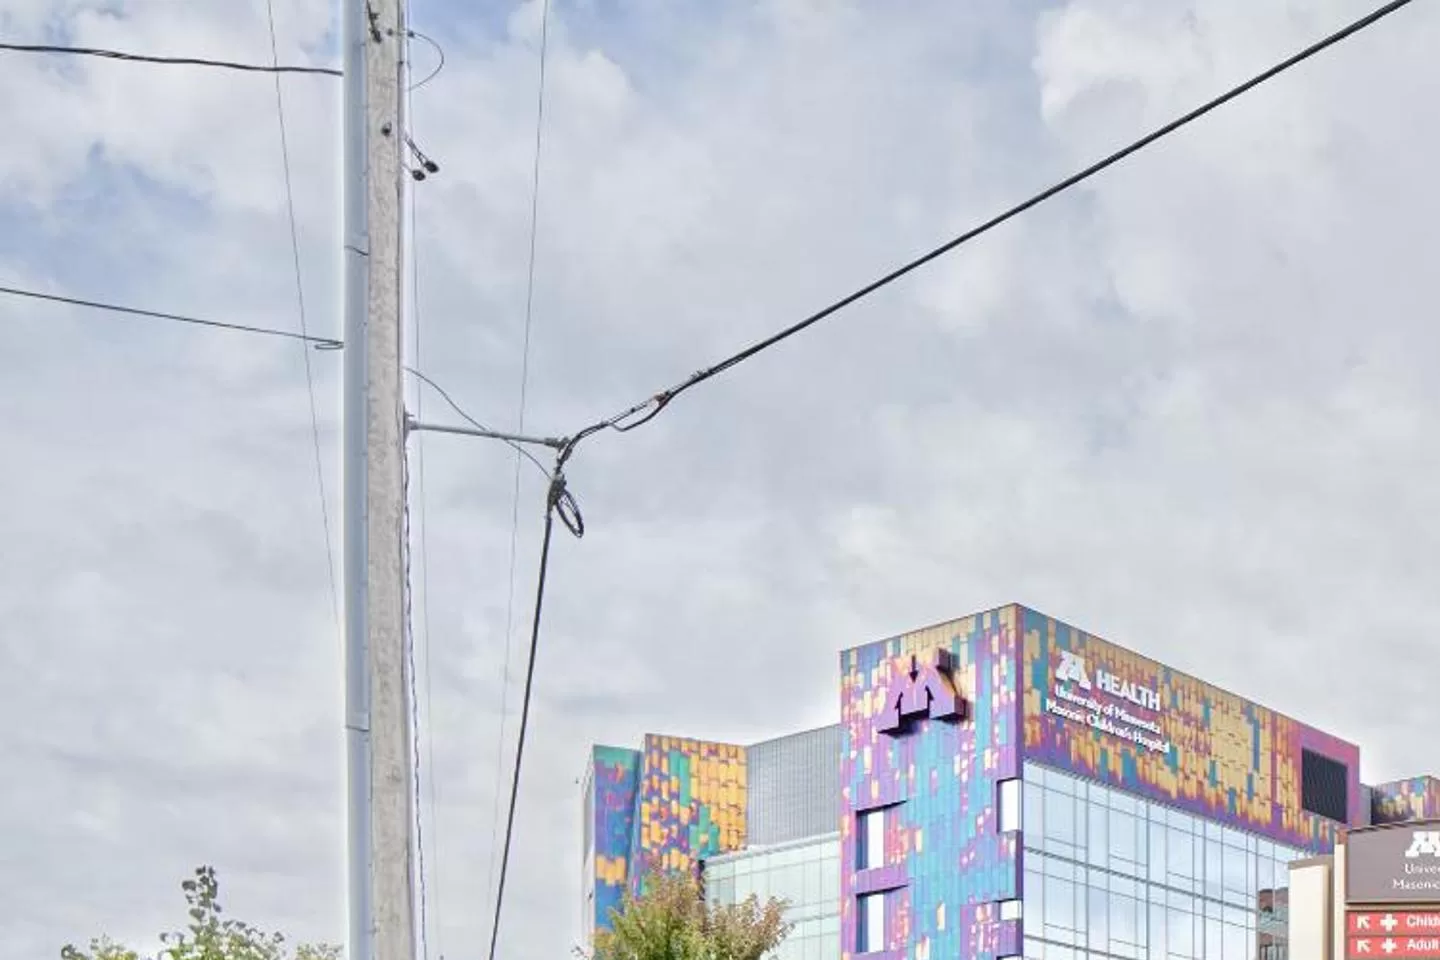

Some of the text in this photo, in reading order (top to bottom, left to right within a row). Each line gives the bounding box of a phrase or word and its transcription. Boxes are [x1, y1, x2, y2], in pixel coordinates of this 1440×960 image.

[1054, 683, 1101, 715] University
[1114, 705, 1161, 734] Minnesota
[1095, 668, 1161, 711] HEALTH
[1046, 698, 1170, 753] Masonic Children's Hospital
[1393, 878, 1440, 889] Masonic
[1407, 939, 1439, 950] Adult
